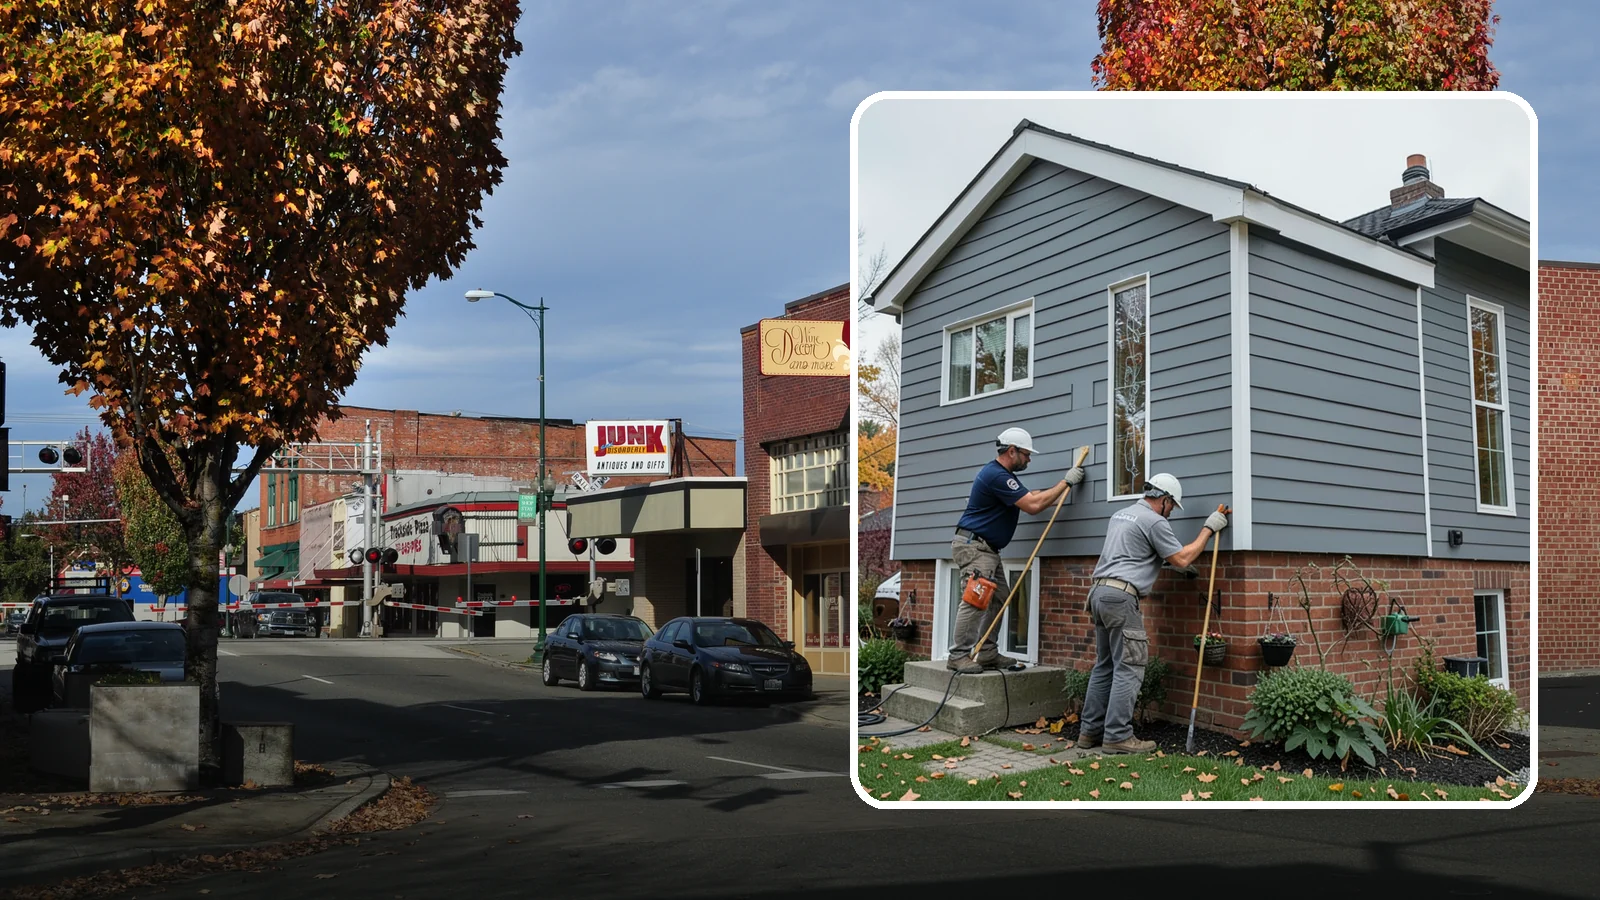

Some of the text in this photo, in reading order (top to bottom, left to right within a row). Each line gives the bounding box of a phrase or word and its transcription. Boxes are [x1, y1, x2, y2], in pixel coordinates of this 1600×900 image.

[595, 425, 666, 457] JUNK
[607, 446, 646, 454] DISORDERLY
[596, 460, 665, 470] ANTIQUES AND GIFTS
[588, 476, 608, 492] SING
[352, 498, 365, 511] CRO
[390, 519, 429, 540] Trackside Pizza
